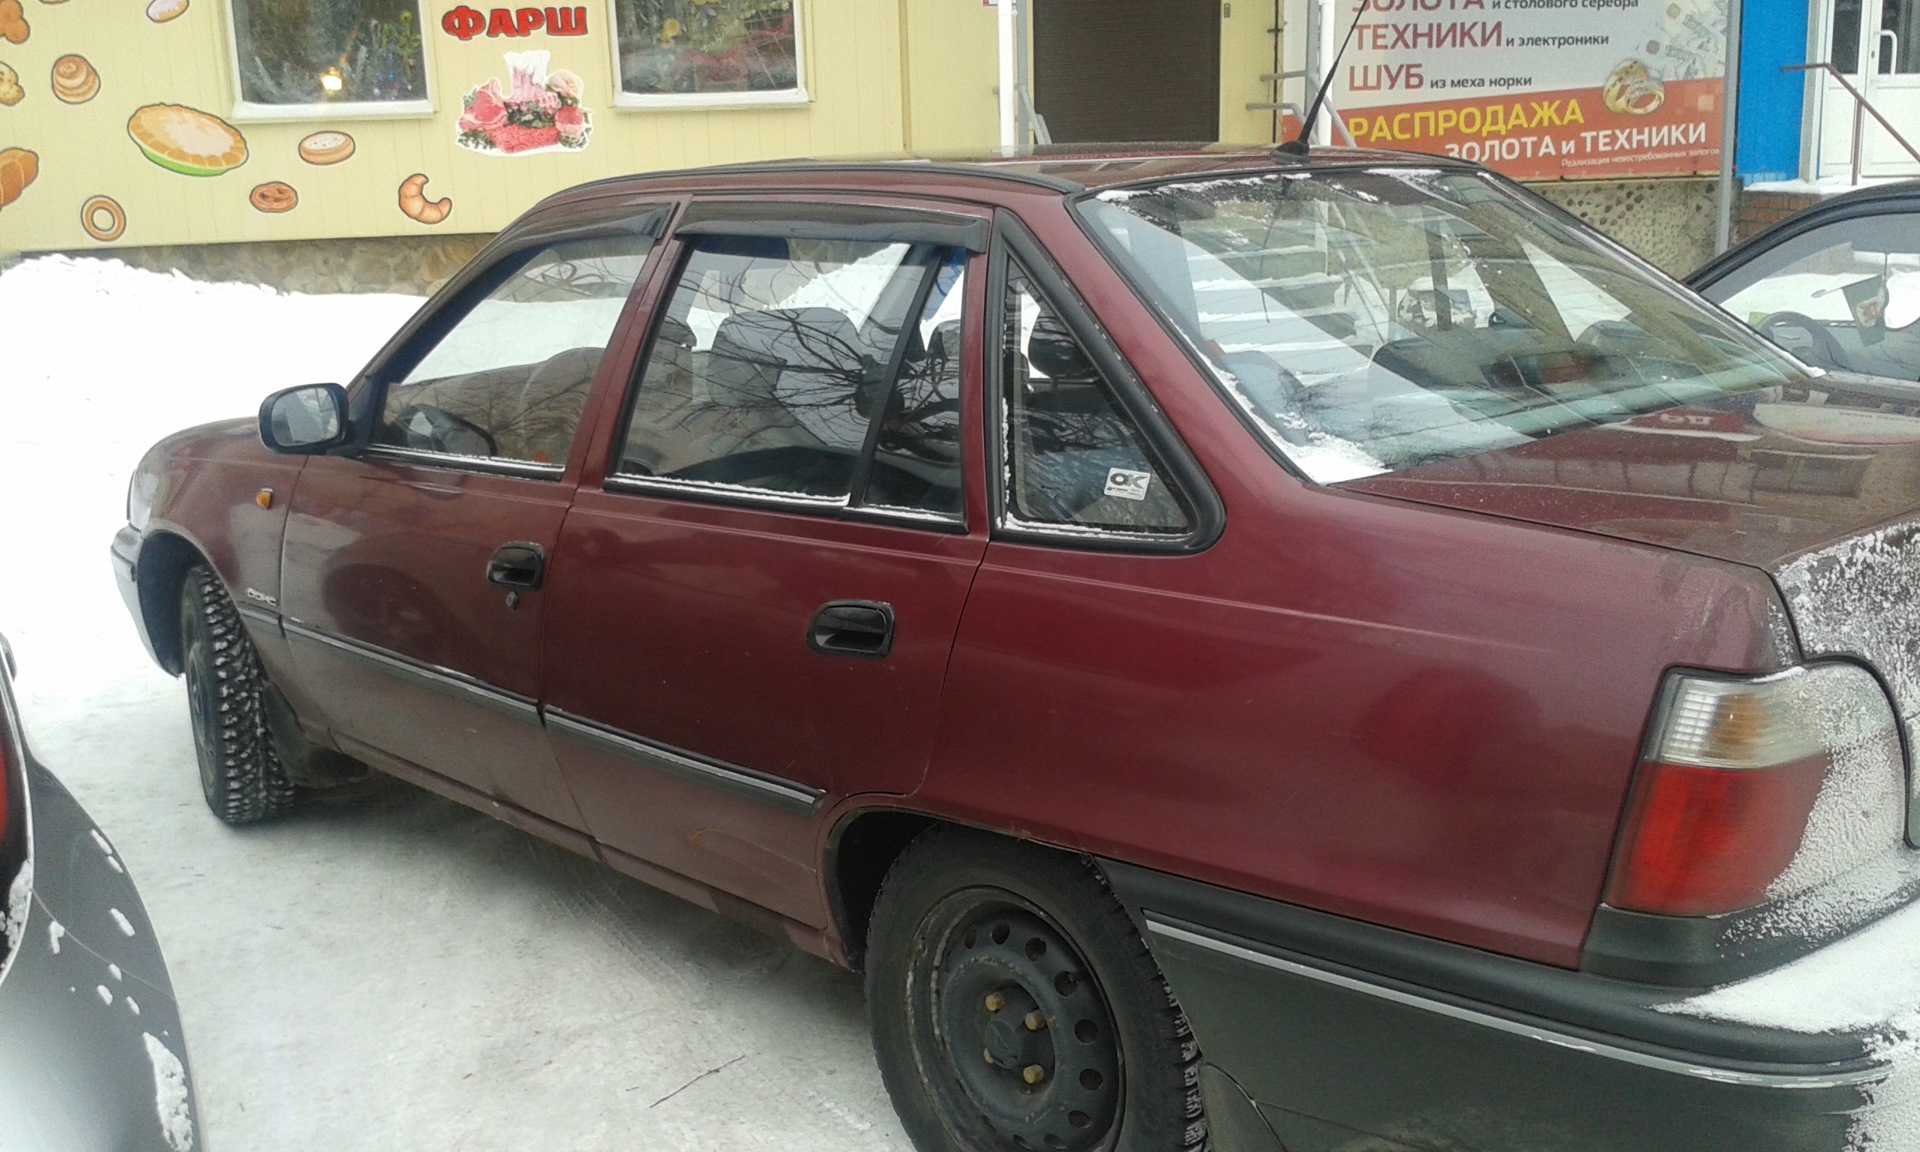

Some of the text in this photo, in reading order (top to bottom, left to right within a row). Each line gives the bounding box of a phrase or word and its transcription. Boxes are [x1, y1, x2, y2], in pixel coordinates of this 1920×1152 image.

[1504, 0, 1578, 9] столового
[1581, 0, 1639, 11] серебра
[442, 5, 588, 41] ФАРШ
[1351, 21, 1609, 51] ТЕХНИКИ и электроники
[1349, 63, 1532, 92] ШУБ из меха норки
[1349, 98, 1585, 143] РАСПРОДАЖА
[1445, 122, 1707, 162] ЗОЛОТА и ТЕХНИКИ
[1561, 157, 1611, 168] Реализация
